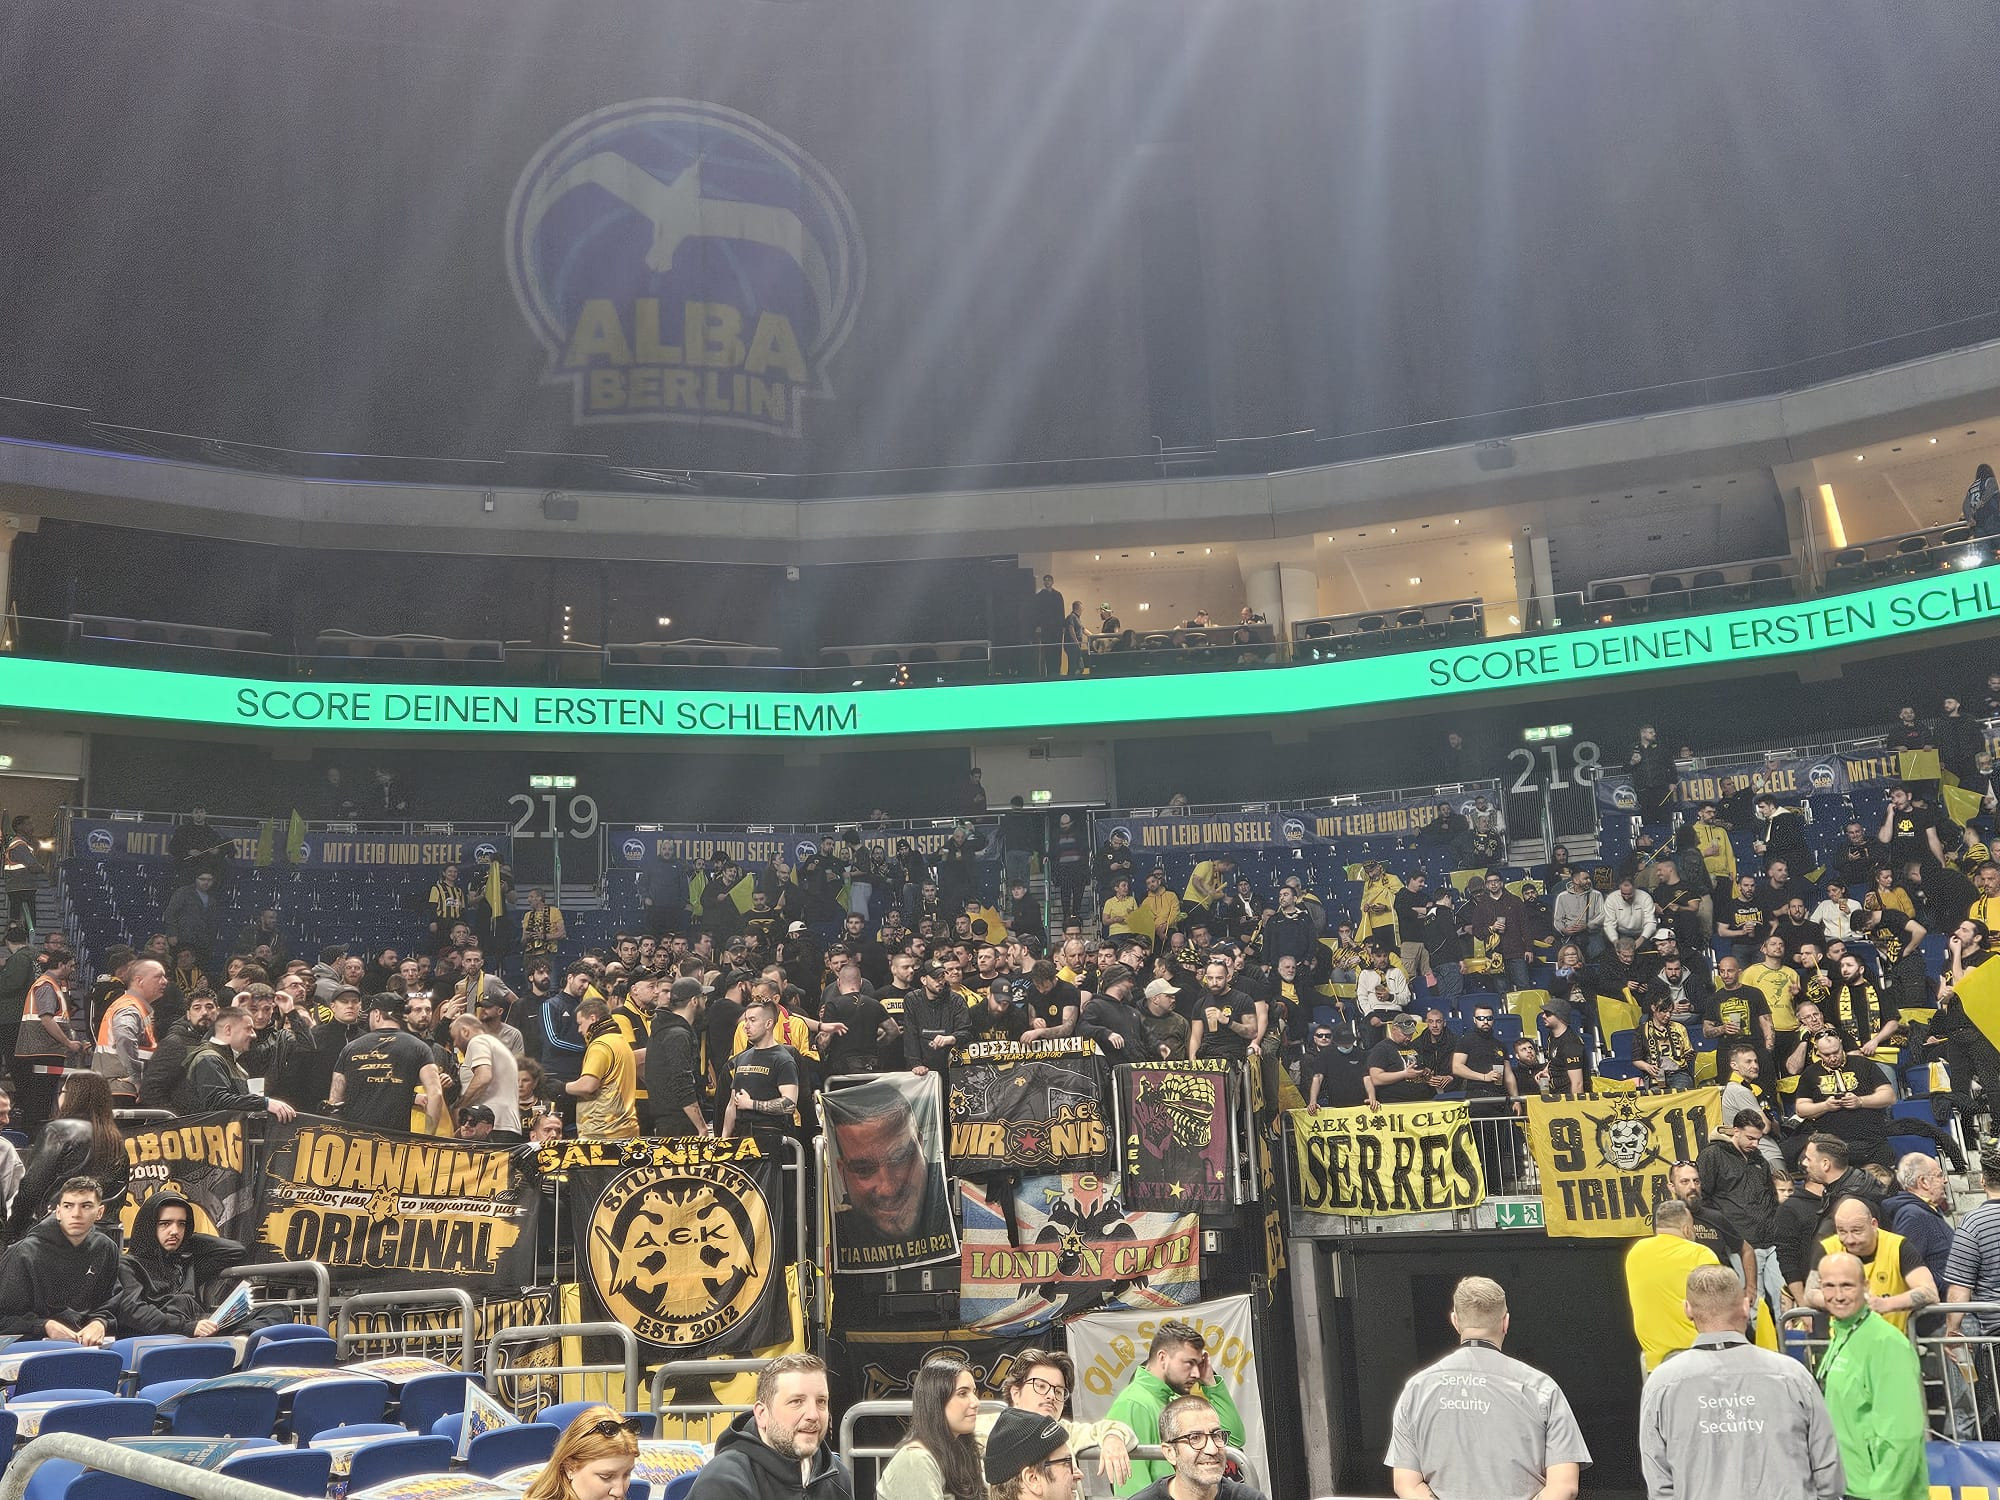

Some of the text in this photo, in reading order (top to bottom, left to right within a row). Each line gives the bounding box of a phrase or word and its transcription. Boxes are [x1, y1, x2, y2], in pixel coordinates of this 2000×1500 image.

[562, 297, 807, 383] ALBA
[588, 368, 786, 419] BERLIN
[1429, 644, 1560, 687] SCORE
[1572, 625, 1712, 669] DEINEN
[1728, 602, 1875, 650] ERSTEN
[236, 687, 858, 732] SCORE DEINEN ERSTEN SCHLEMM
[1507, 740, 1605, 794] 218
[1846, 758, 1878, 783] MIT
[1681, 778, 1714, 801] LEIB
[507, 794, 598, 839] 219
[1316, 816, 1343, 837] MIT
[1345, 813, 1375, 836] LEIB
[1377, 809, 1407, 833] UND
[127, 831, 158, 856] MIT
[1142, 821, 1272, 847] MIT LEIB UND SEELE
[323, 842, 463, 865] MIT LEIB UND SEELE
[685, 840, 714, 861] LEIB
[1309, 1105, 1468, 1133] AEK 9 11 CLUB
[1548, 1105, 1709, 1172] 9 11
[293, 1130, 511, 1201] IOANNINA
[1303, 1123, 1479, 1211] SERRES
[297, 1187, 340, 1207] πάθος
[401, 1200, 417, 1210] το
[493, 1205, 518, 1217] μας
[602, 1163, 754, 1212] STUTTGART
[284, 1209, 494, 1273] ORIGINAL
[862, 1243, 905, 1263] ΠΑΝΤΑ
[906, 1238, 928, 1257] ΕΔΩ
[1113, 1234, 1192, 1276] CLUB
[633, 1305, 740, 1342] EST. 2012
[1083, 1334, 1137, 1397] OLD
[1440, 1373, 1487, 1387] Service
[1439, 1397, 1491, 1415] Security
[1698, 1392, 1756, 1409] Service
[1726, 1409, 1736, 1420] &
[1698, 1417, 1765, 1434] Security
